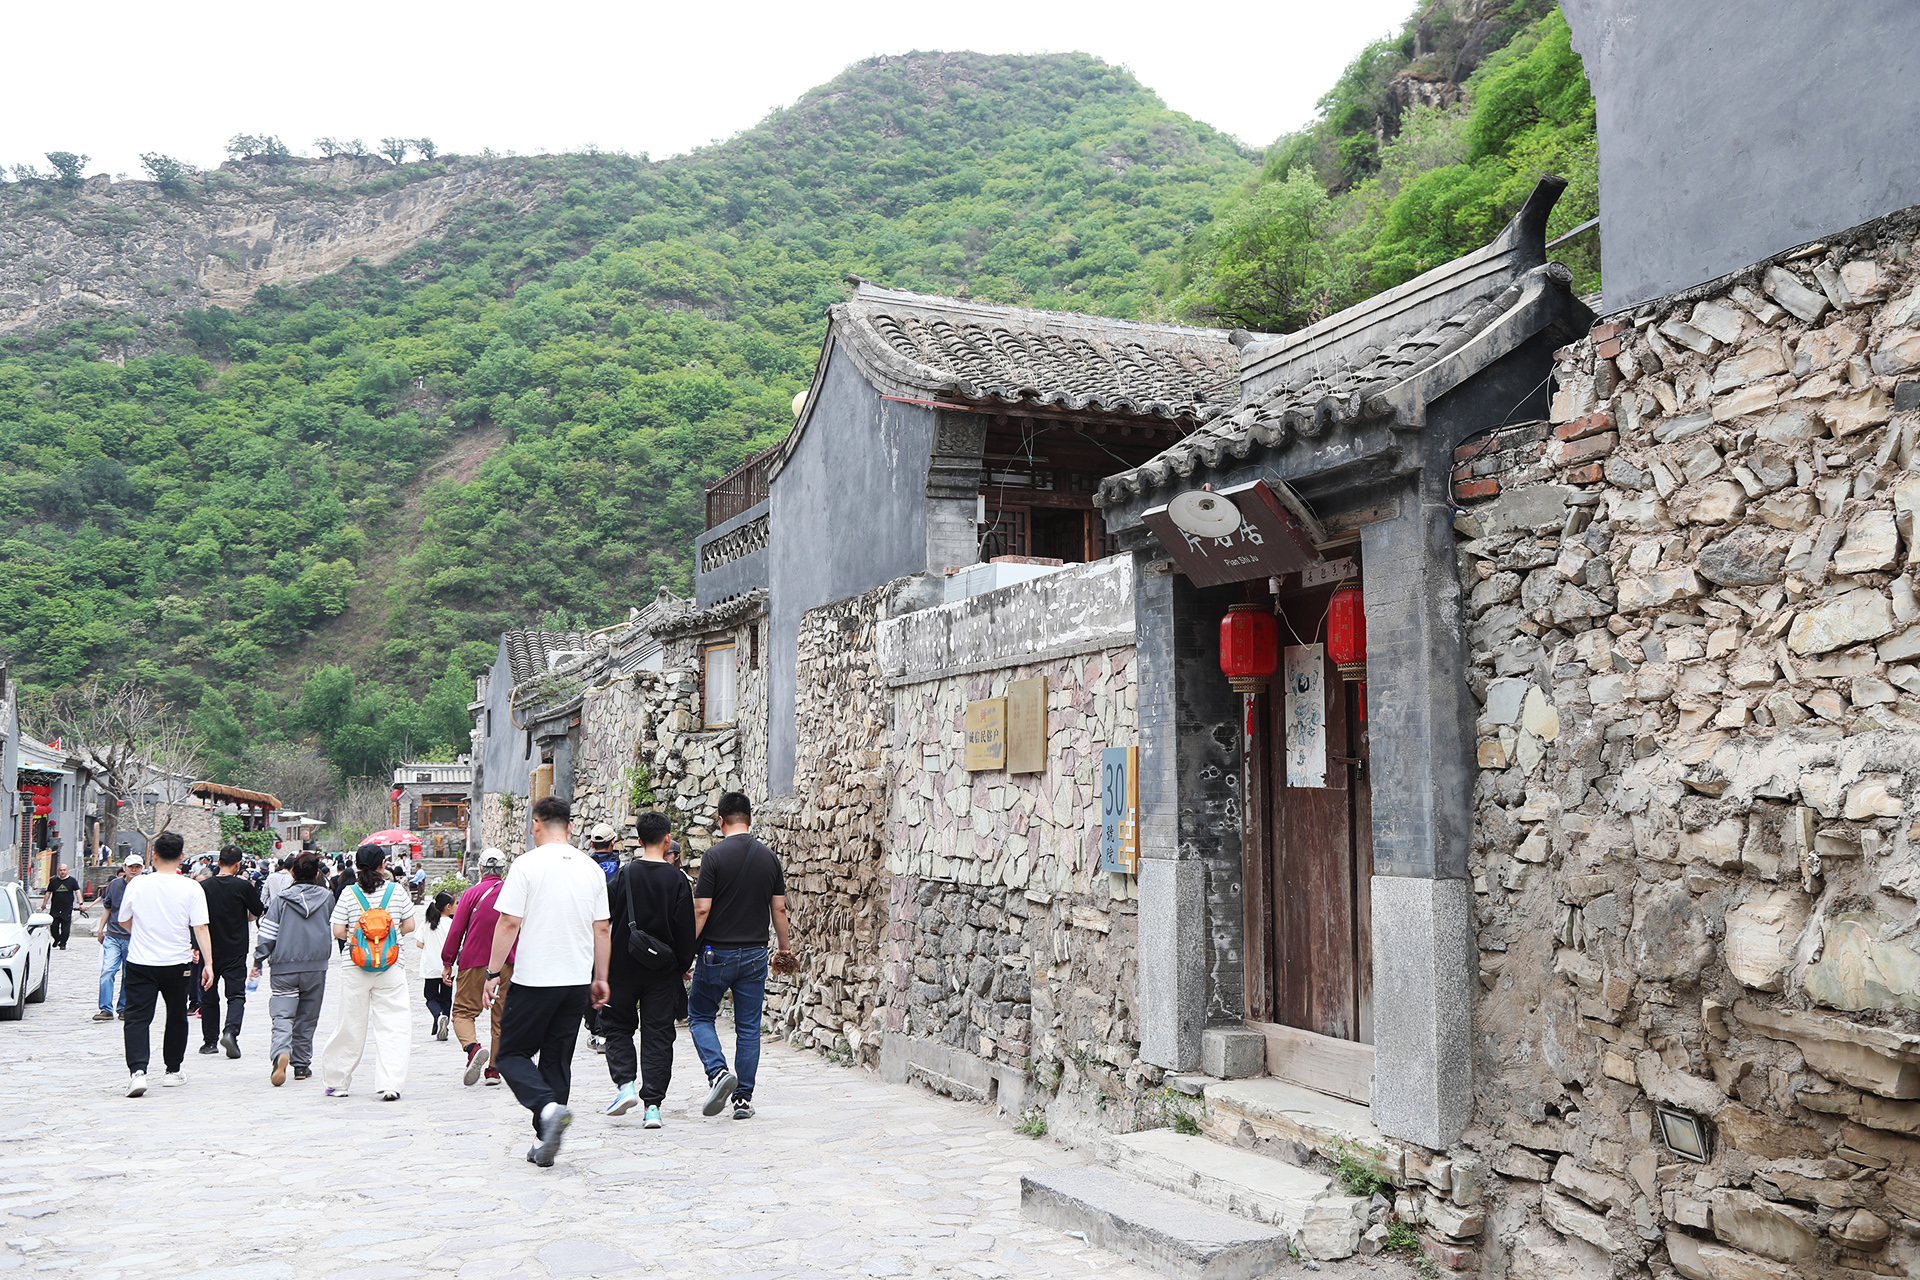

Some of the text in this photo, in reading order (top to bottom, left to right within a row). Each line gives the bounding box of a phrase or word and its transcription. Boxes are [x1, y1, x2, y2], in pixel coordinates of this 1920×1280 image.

[1223, 554, 1260, 567] Pian Shi Ju
[1105, 762, 1125, 817] 30
